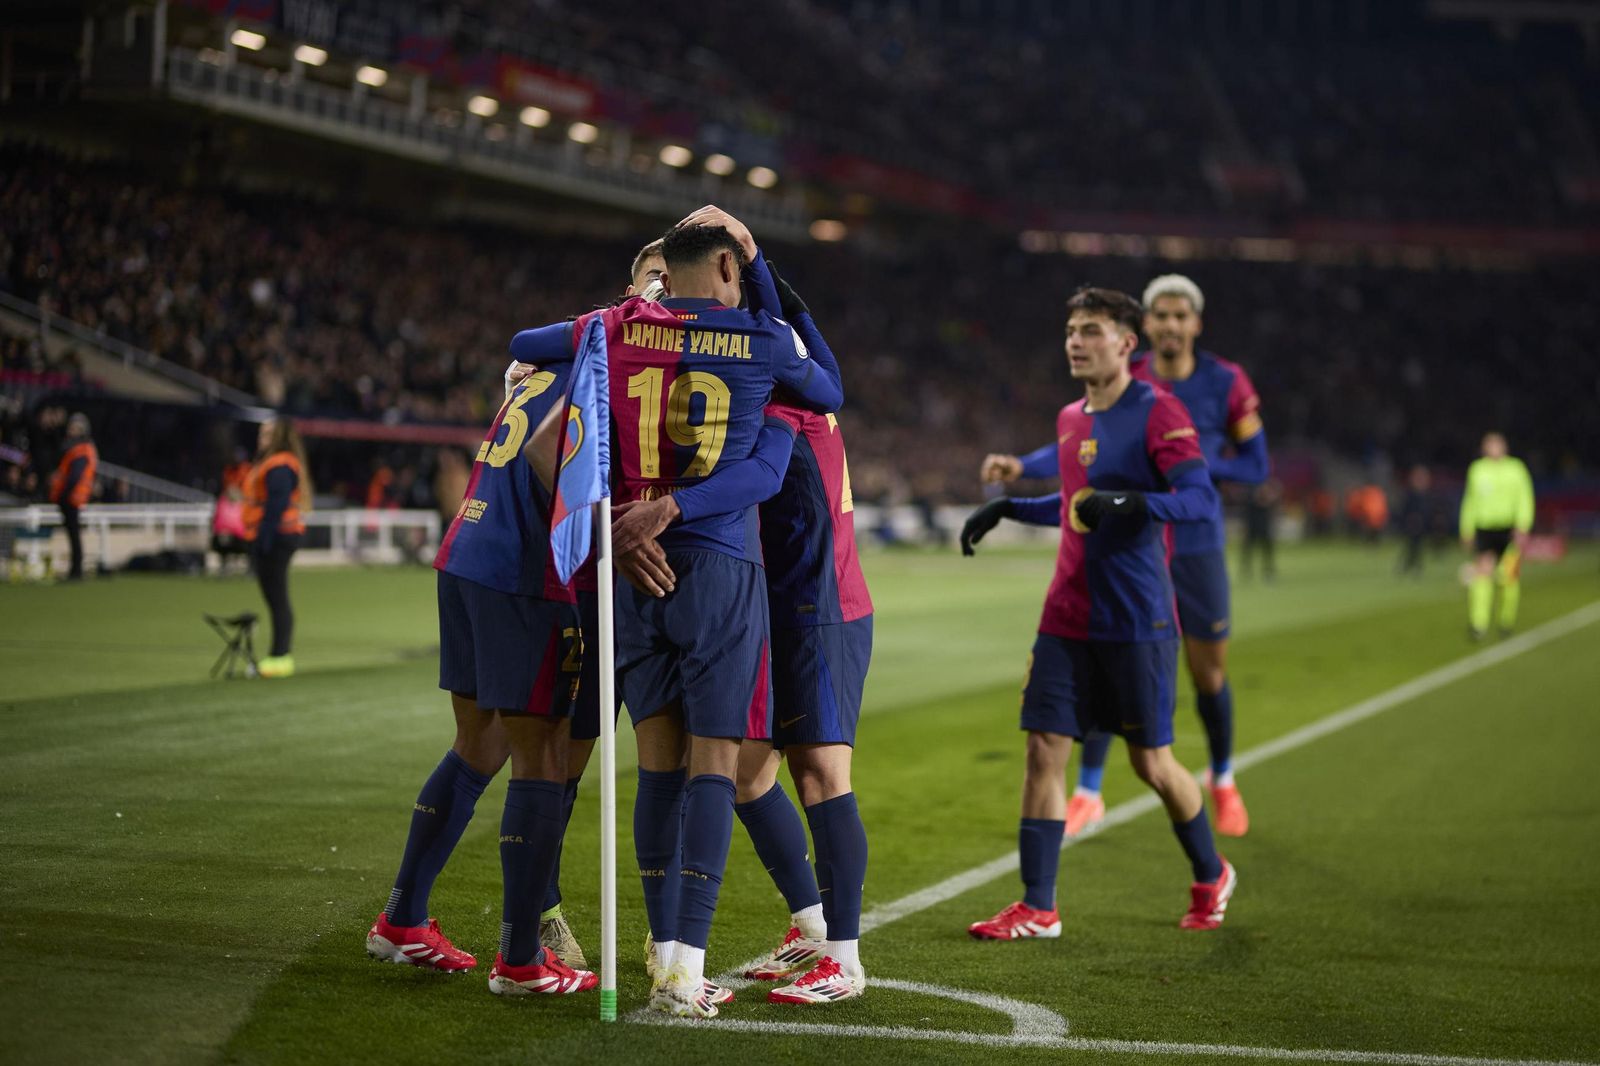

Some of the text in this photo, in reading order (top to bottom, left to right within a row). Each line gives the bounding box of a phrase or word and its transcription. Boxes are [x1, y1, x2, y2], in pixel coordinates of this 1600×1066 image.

[622, 322, 753, 360] LAMINE YAMAL
[475, 370, 557, 468] 3
[627, 366, 732, 479] 19
[561, 627, 585, 673] 2
